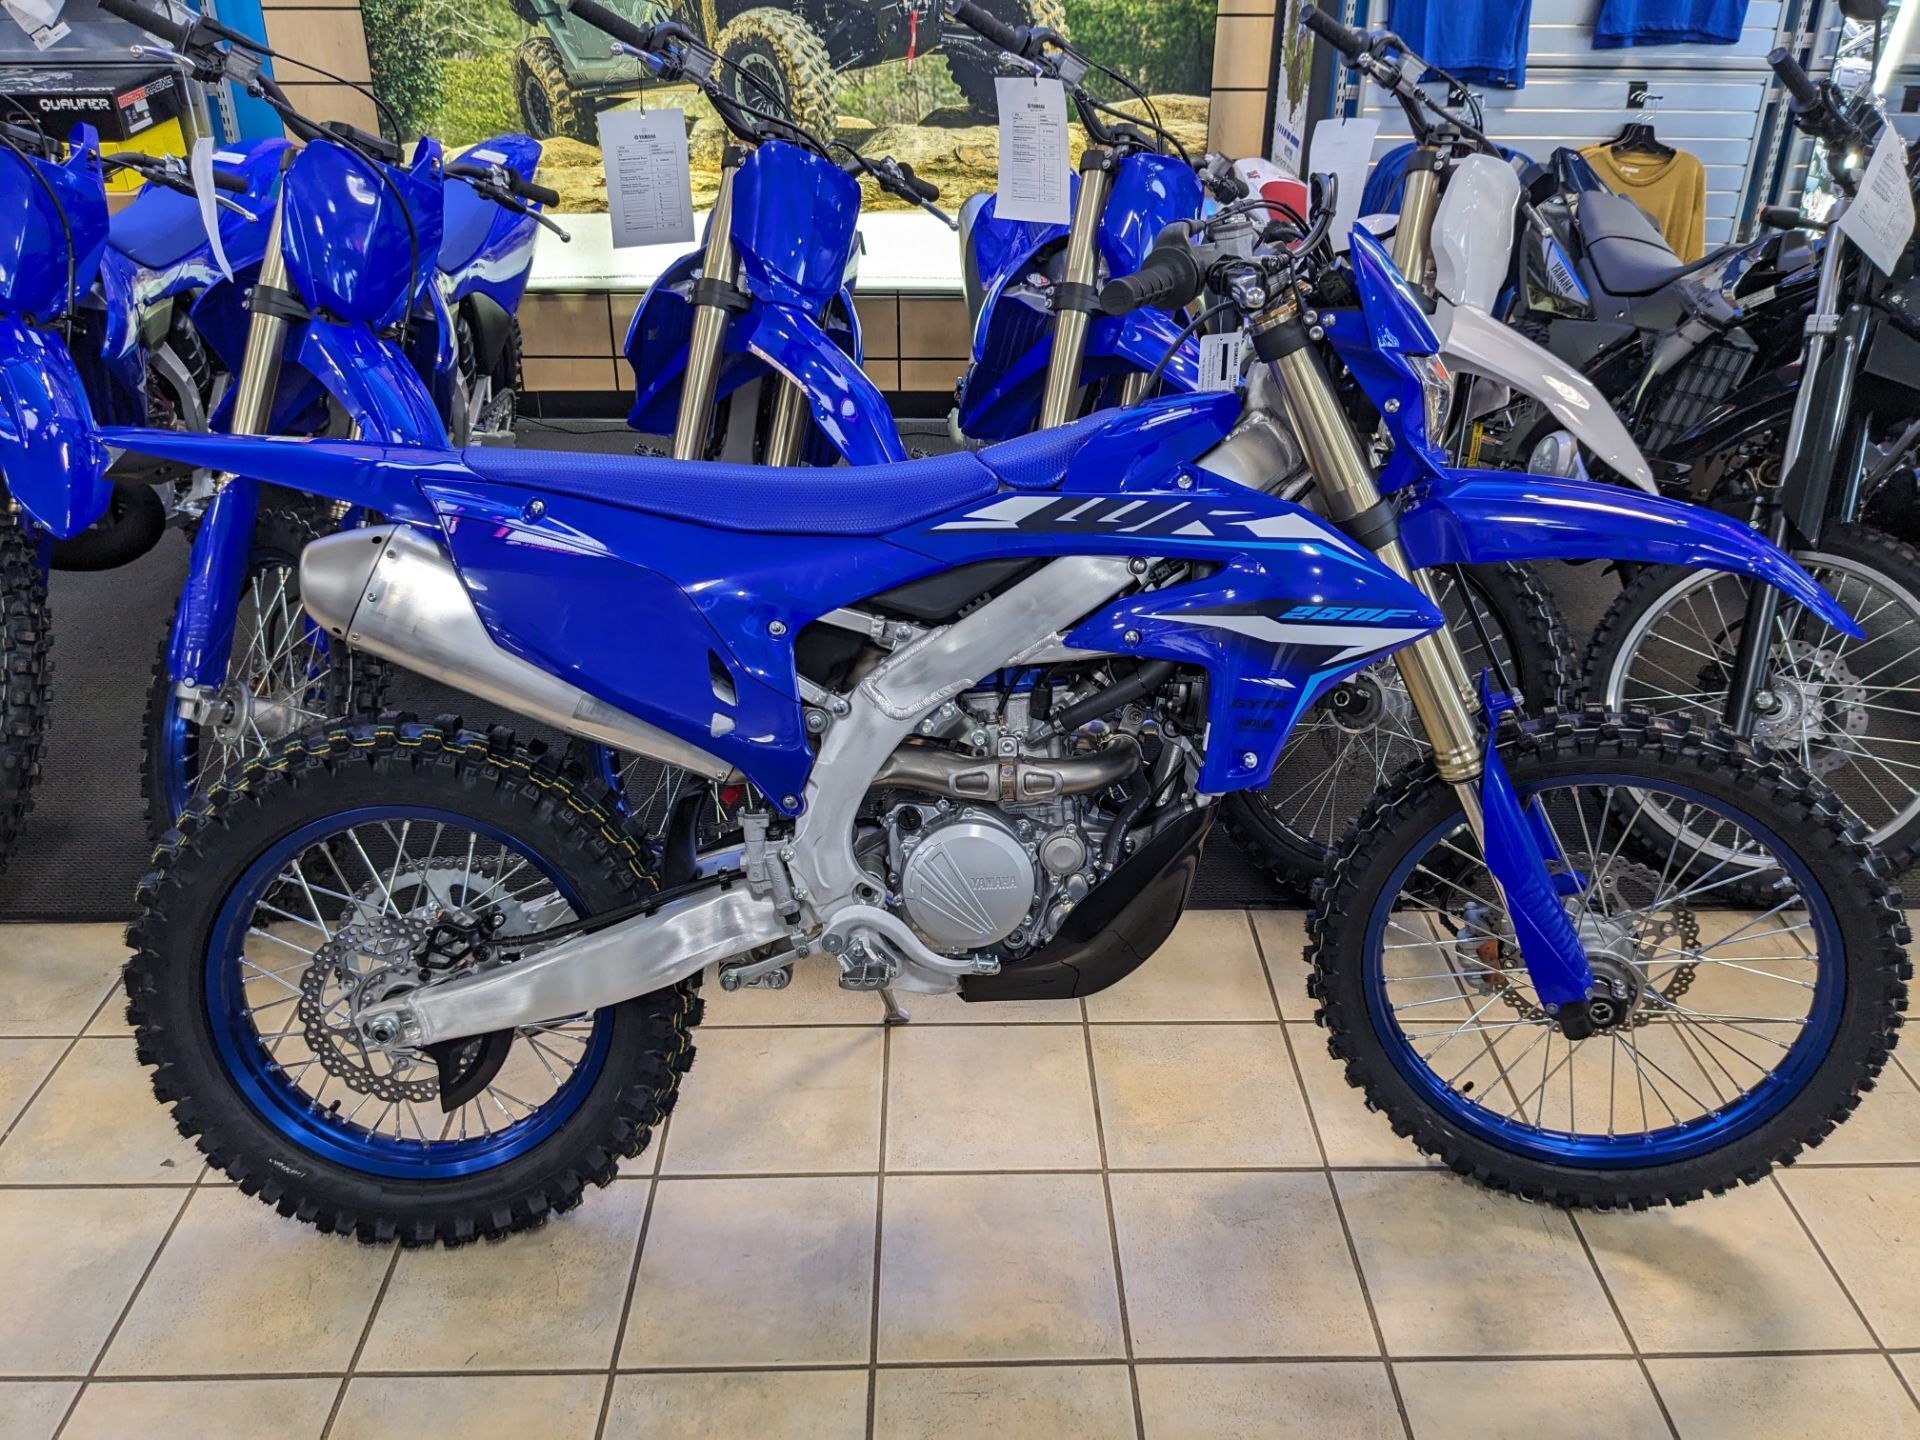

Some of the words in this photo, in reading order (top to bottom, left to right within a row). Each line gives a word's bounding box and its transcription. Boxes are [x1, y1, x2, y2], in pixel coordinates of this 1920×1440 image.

[40, 98, 111, 112] QUALIFIER
[1551, 260, 1575, 294] YAMAHA
[1278, 606, 1418, 622] 250F
[970, 875, 1018, 891] YAMAHA
